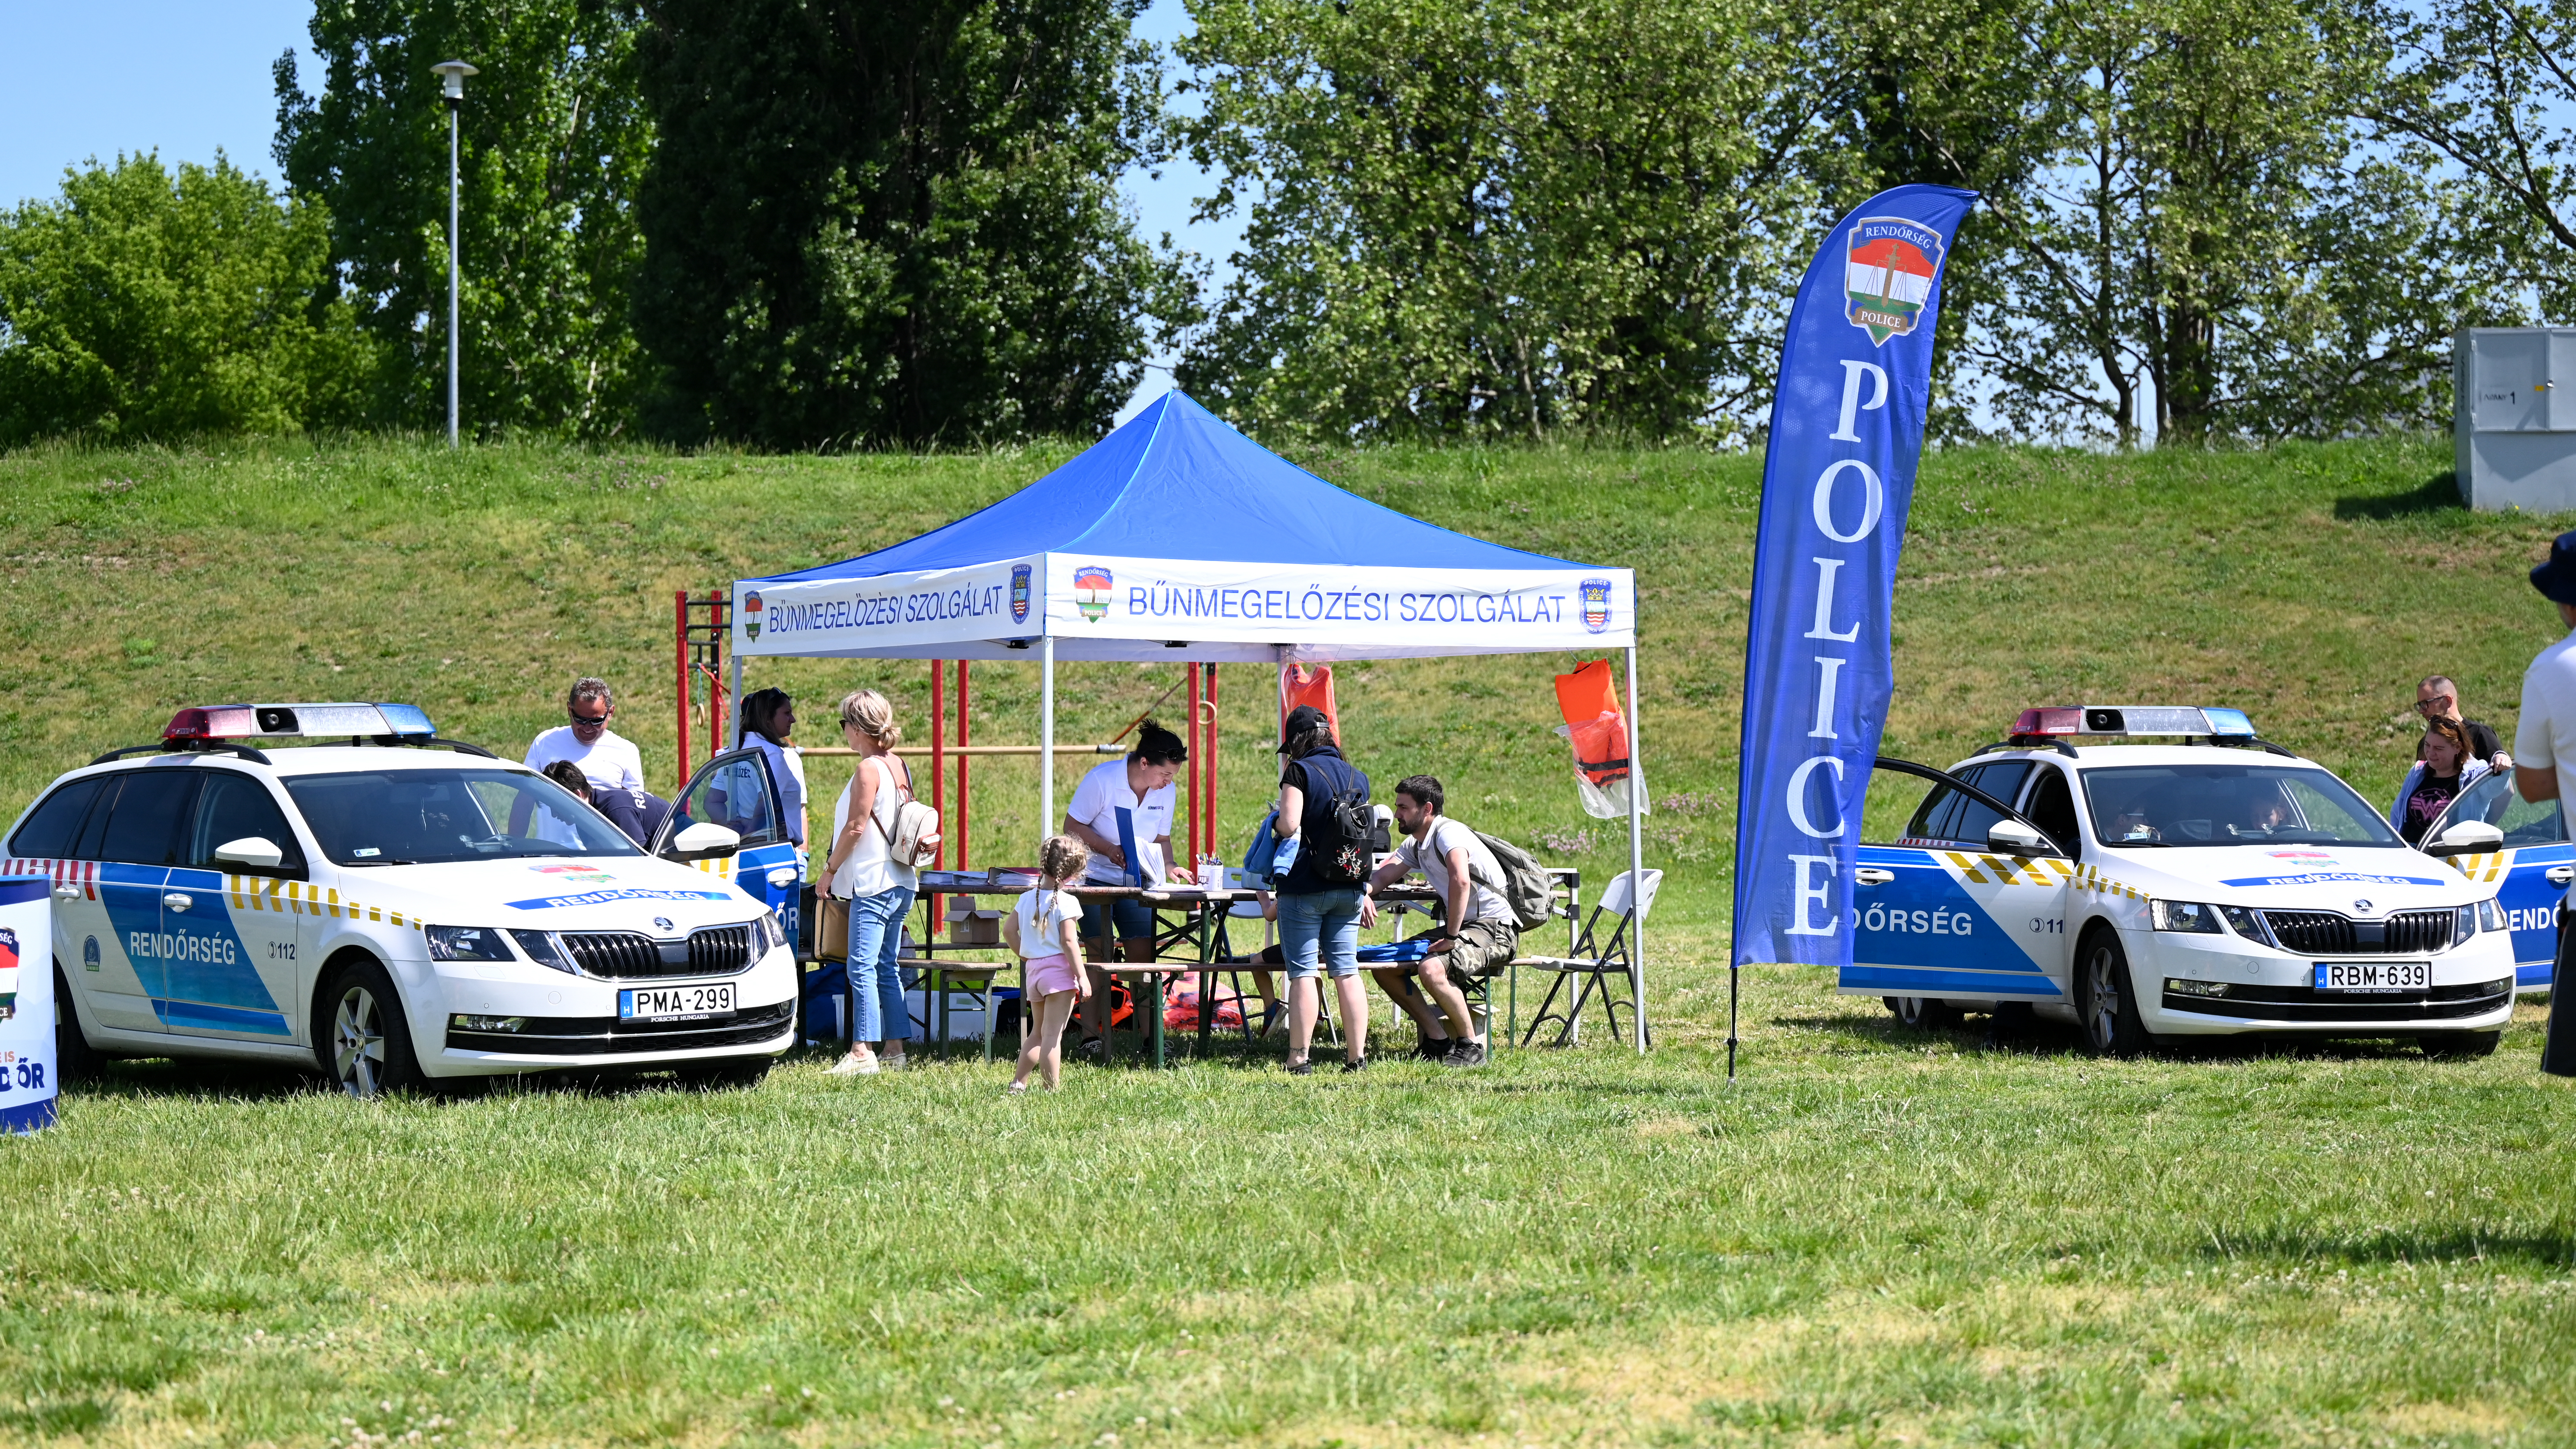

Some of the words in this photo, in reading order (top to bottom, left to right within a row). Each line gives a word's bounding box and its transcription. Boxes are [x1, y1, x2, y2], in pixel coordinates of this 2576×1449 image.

[1865, 226, 1932, 249] RENDŐRSÉG
[1861, 311, 1901, 328] POLICE
[1079, 568, 1108, 577] RENDŐRSÉG
[770, 592, 902, 632] BŰNMEGELŐZÉSI
[906, 582, 1002, 622] SZOLGÁLAT
[1129, 580, 1389, 621] BŰNMEGELŐZÉSI
[1401, 585, 1565, 623] SZOLGÁLAT
[1784, 359, 1889, 936] POLICE
[2267, 873, 2411, 885] RENDŐRSÉG
[545, 889, 707, 907] RENDŐRSÉG
[1853, 903, 1971, 935] ŐRSÉG
[2047, 919, 2063, 933] 11
[131, 929, 236, 964] RENDŐRSÉG
[278, 942, 295, 960] 112
[2332, 966, 2424, 986] RBM-639
[637, 988, 729, 1014] PMA-299
[5, 1051, 15, 1062] IS
